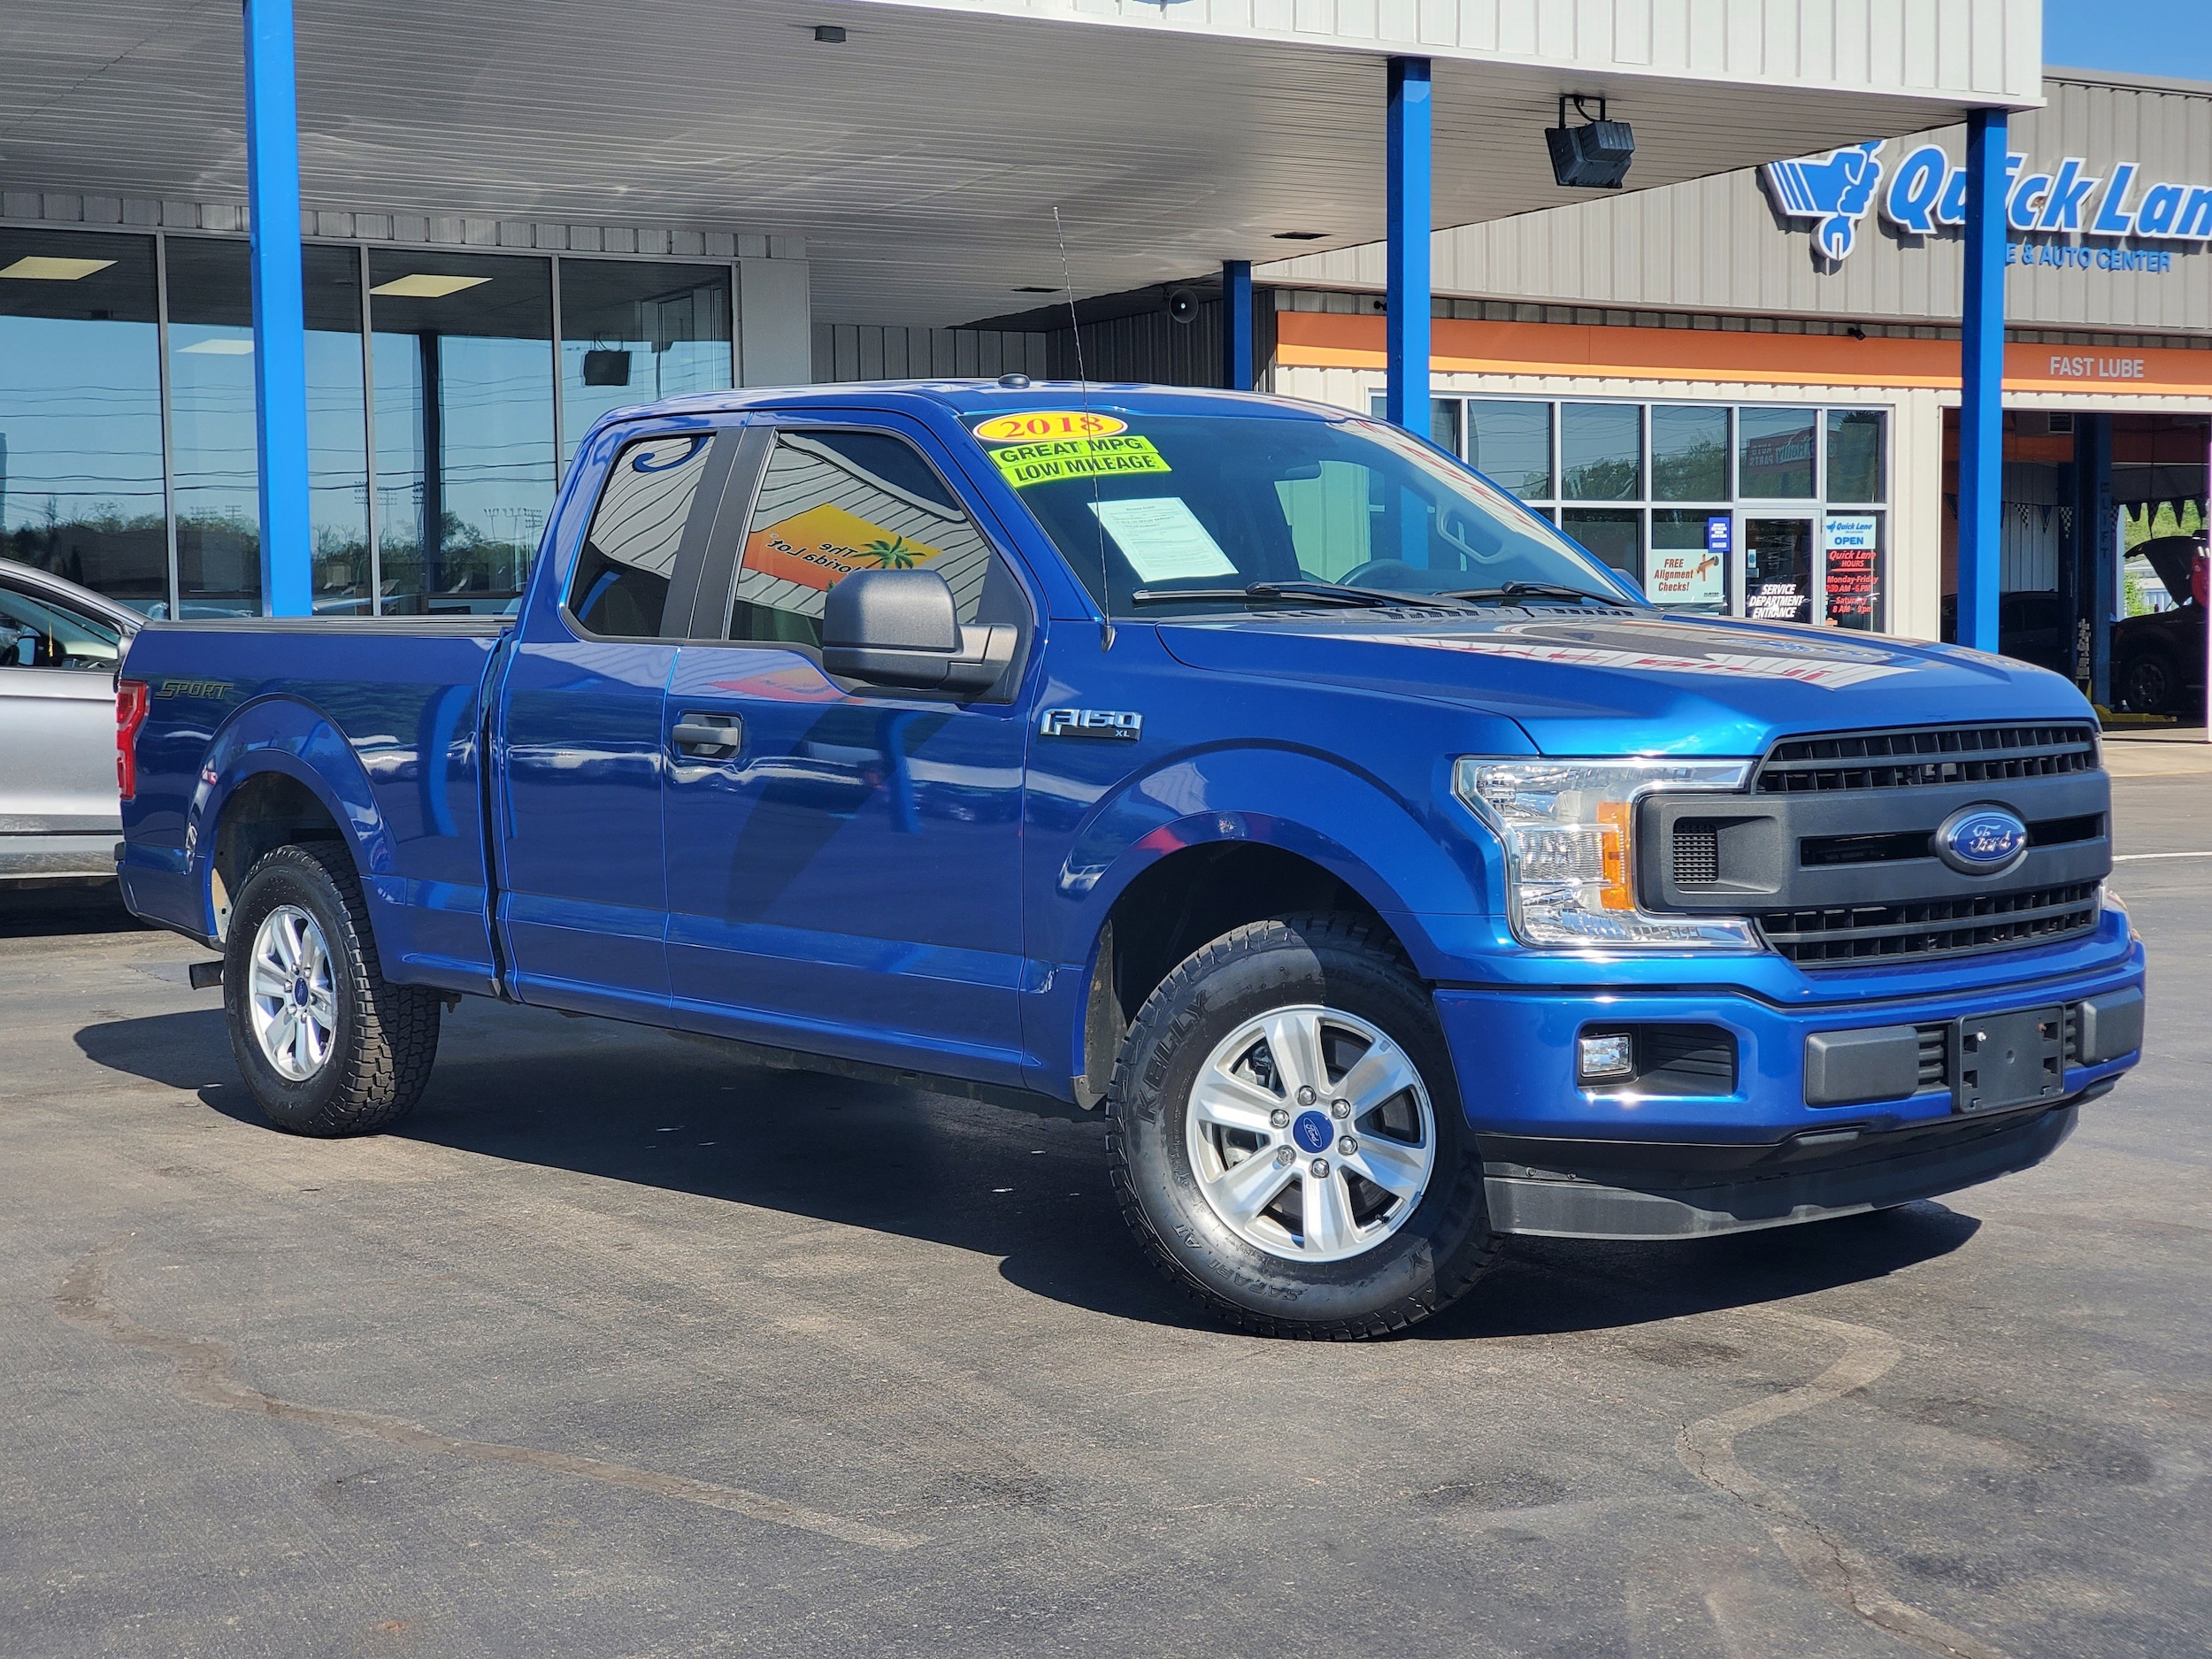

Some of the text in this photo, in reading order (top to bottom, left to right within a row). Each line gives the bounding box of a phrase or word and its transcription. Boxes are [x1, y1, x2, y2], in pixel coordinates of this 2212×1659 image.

[2089, 161, 2211, 240] Lan
[2022, 244, 2033, 265] &
[2039, 244, 2093, 268] AUTO
[2096, 248, 2170, 273] CENTER
[2050, 357, 2145, 378] FAST LUBE
[1000, 415, 1103, 438] 2018
[1000, 437, 1143, 464] GREAT MPG
[1015, 455, 1156, 481] LOW MILEAGE
[1836, 522, 1855, 531] Quick
[1834, 536, 1864, 545] OPEN
[1829, 550, 1877, 561] Quick Lane
[1663, 558, 1684, 568] FREE
[1654, 569, 1694, 580] Alignment
[1658, 582, 1690, 591] Checks!
[1761, 584, 1797, 595] SERVICE
[1748, 595, 1805, 607] DEPARTMENT
[1836, 596, 1868, 605] Saturay
[1753, 607, 1797, 618] ENTRANCE
[154, 679, 234, 700] SPORT
[1969, 824, 2011, 853] Ford
[1136, 989, 1209, 1125] KELLY
